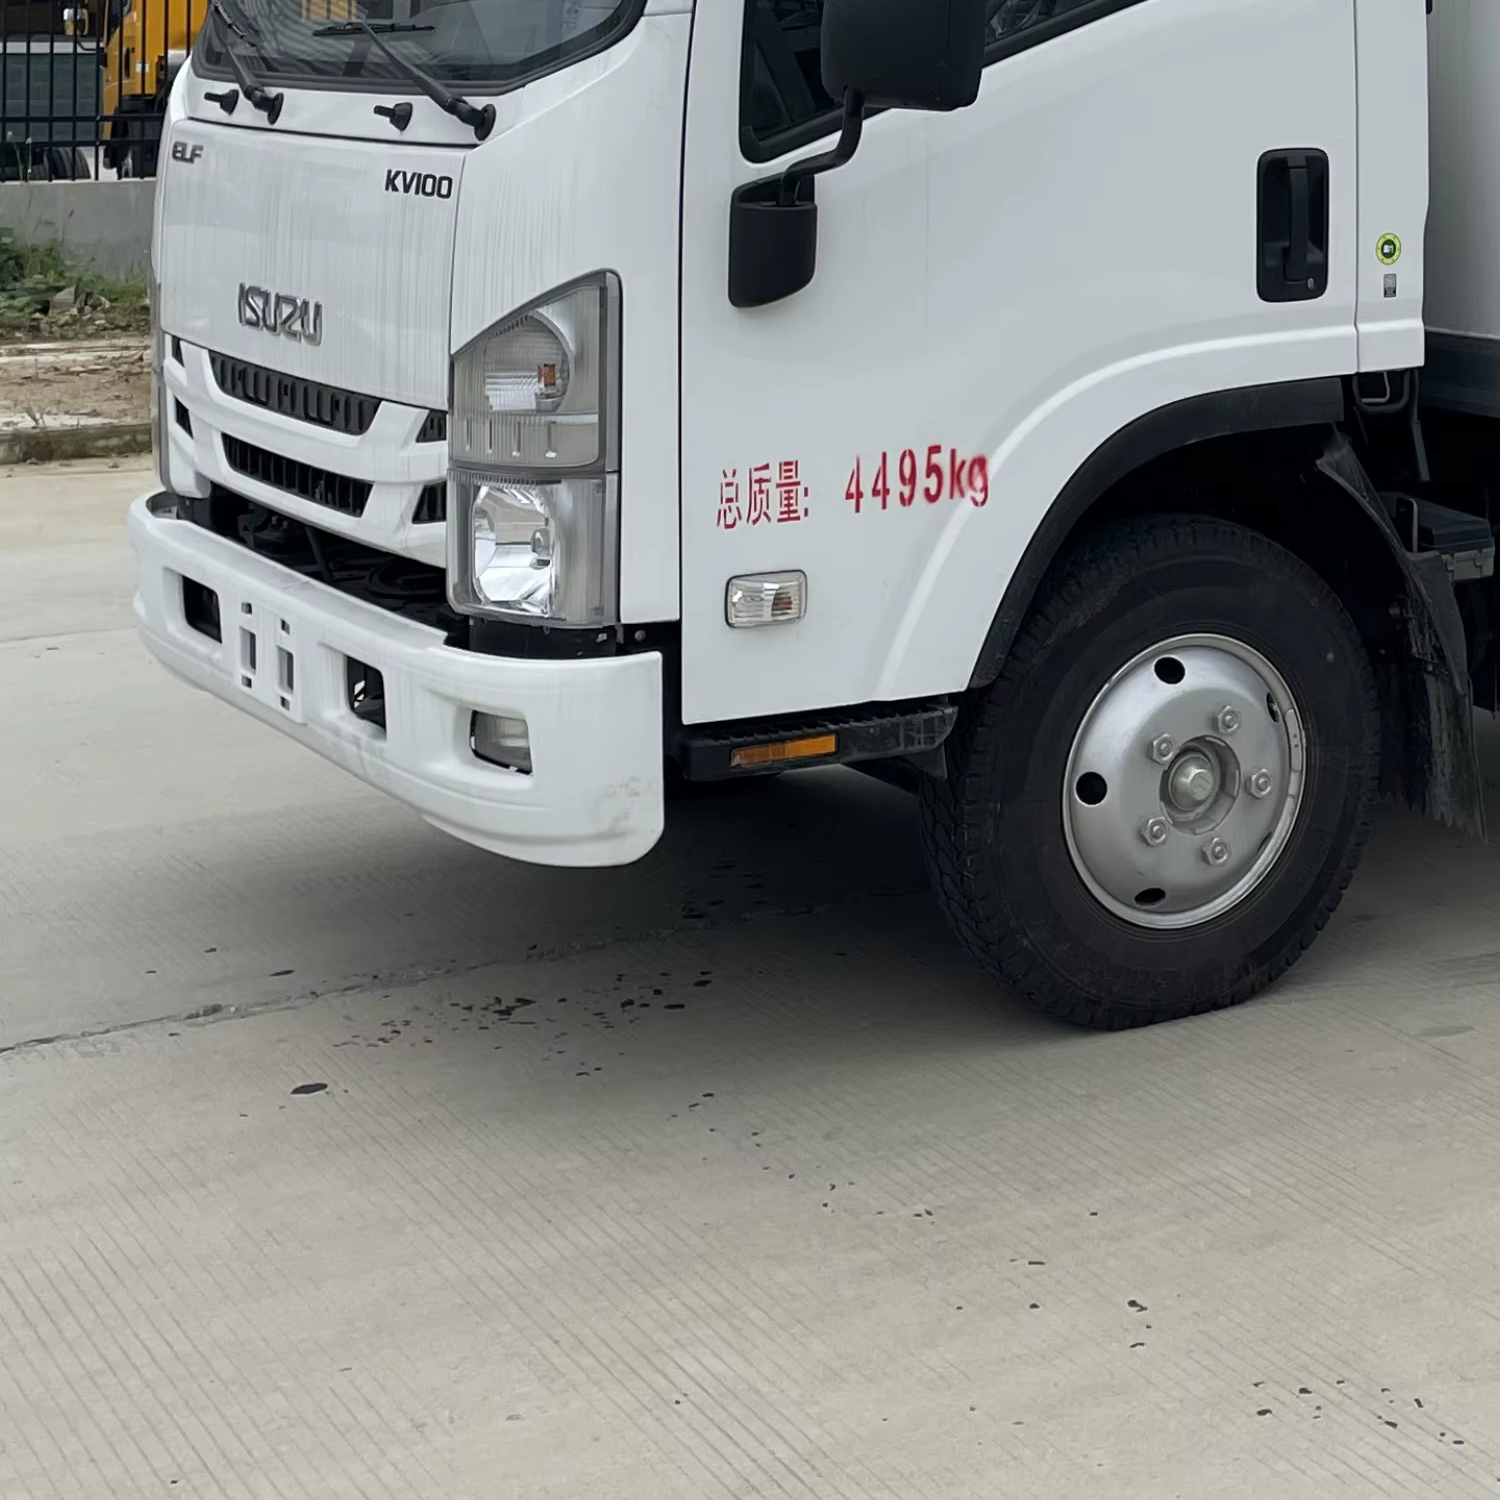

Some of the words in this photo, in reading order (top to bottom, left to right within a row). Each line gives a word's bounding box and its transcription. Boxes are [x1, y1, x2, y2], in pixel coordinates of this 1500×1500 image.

[172, 141, 204, 164] ELF
[384, 168, 453, 200] KV100
[238, 282, 323, 347] ISUZU
[844, 444, 991, 514] 4495kg
